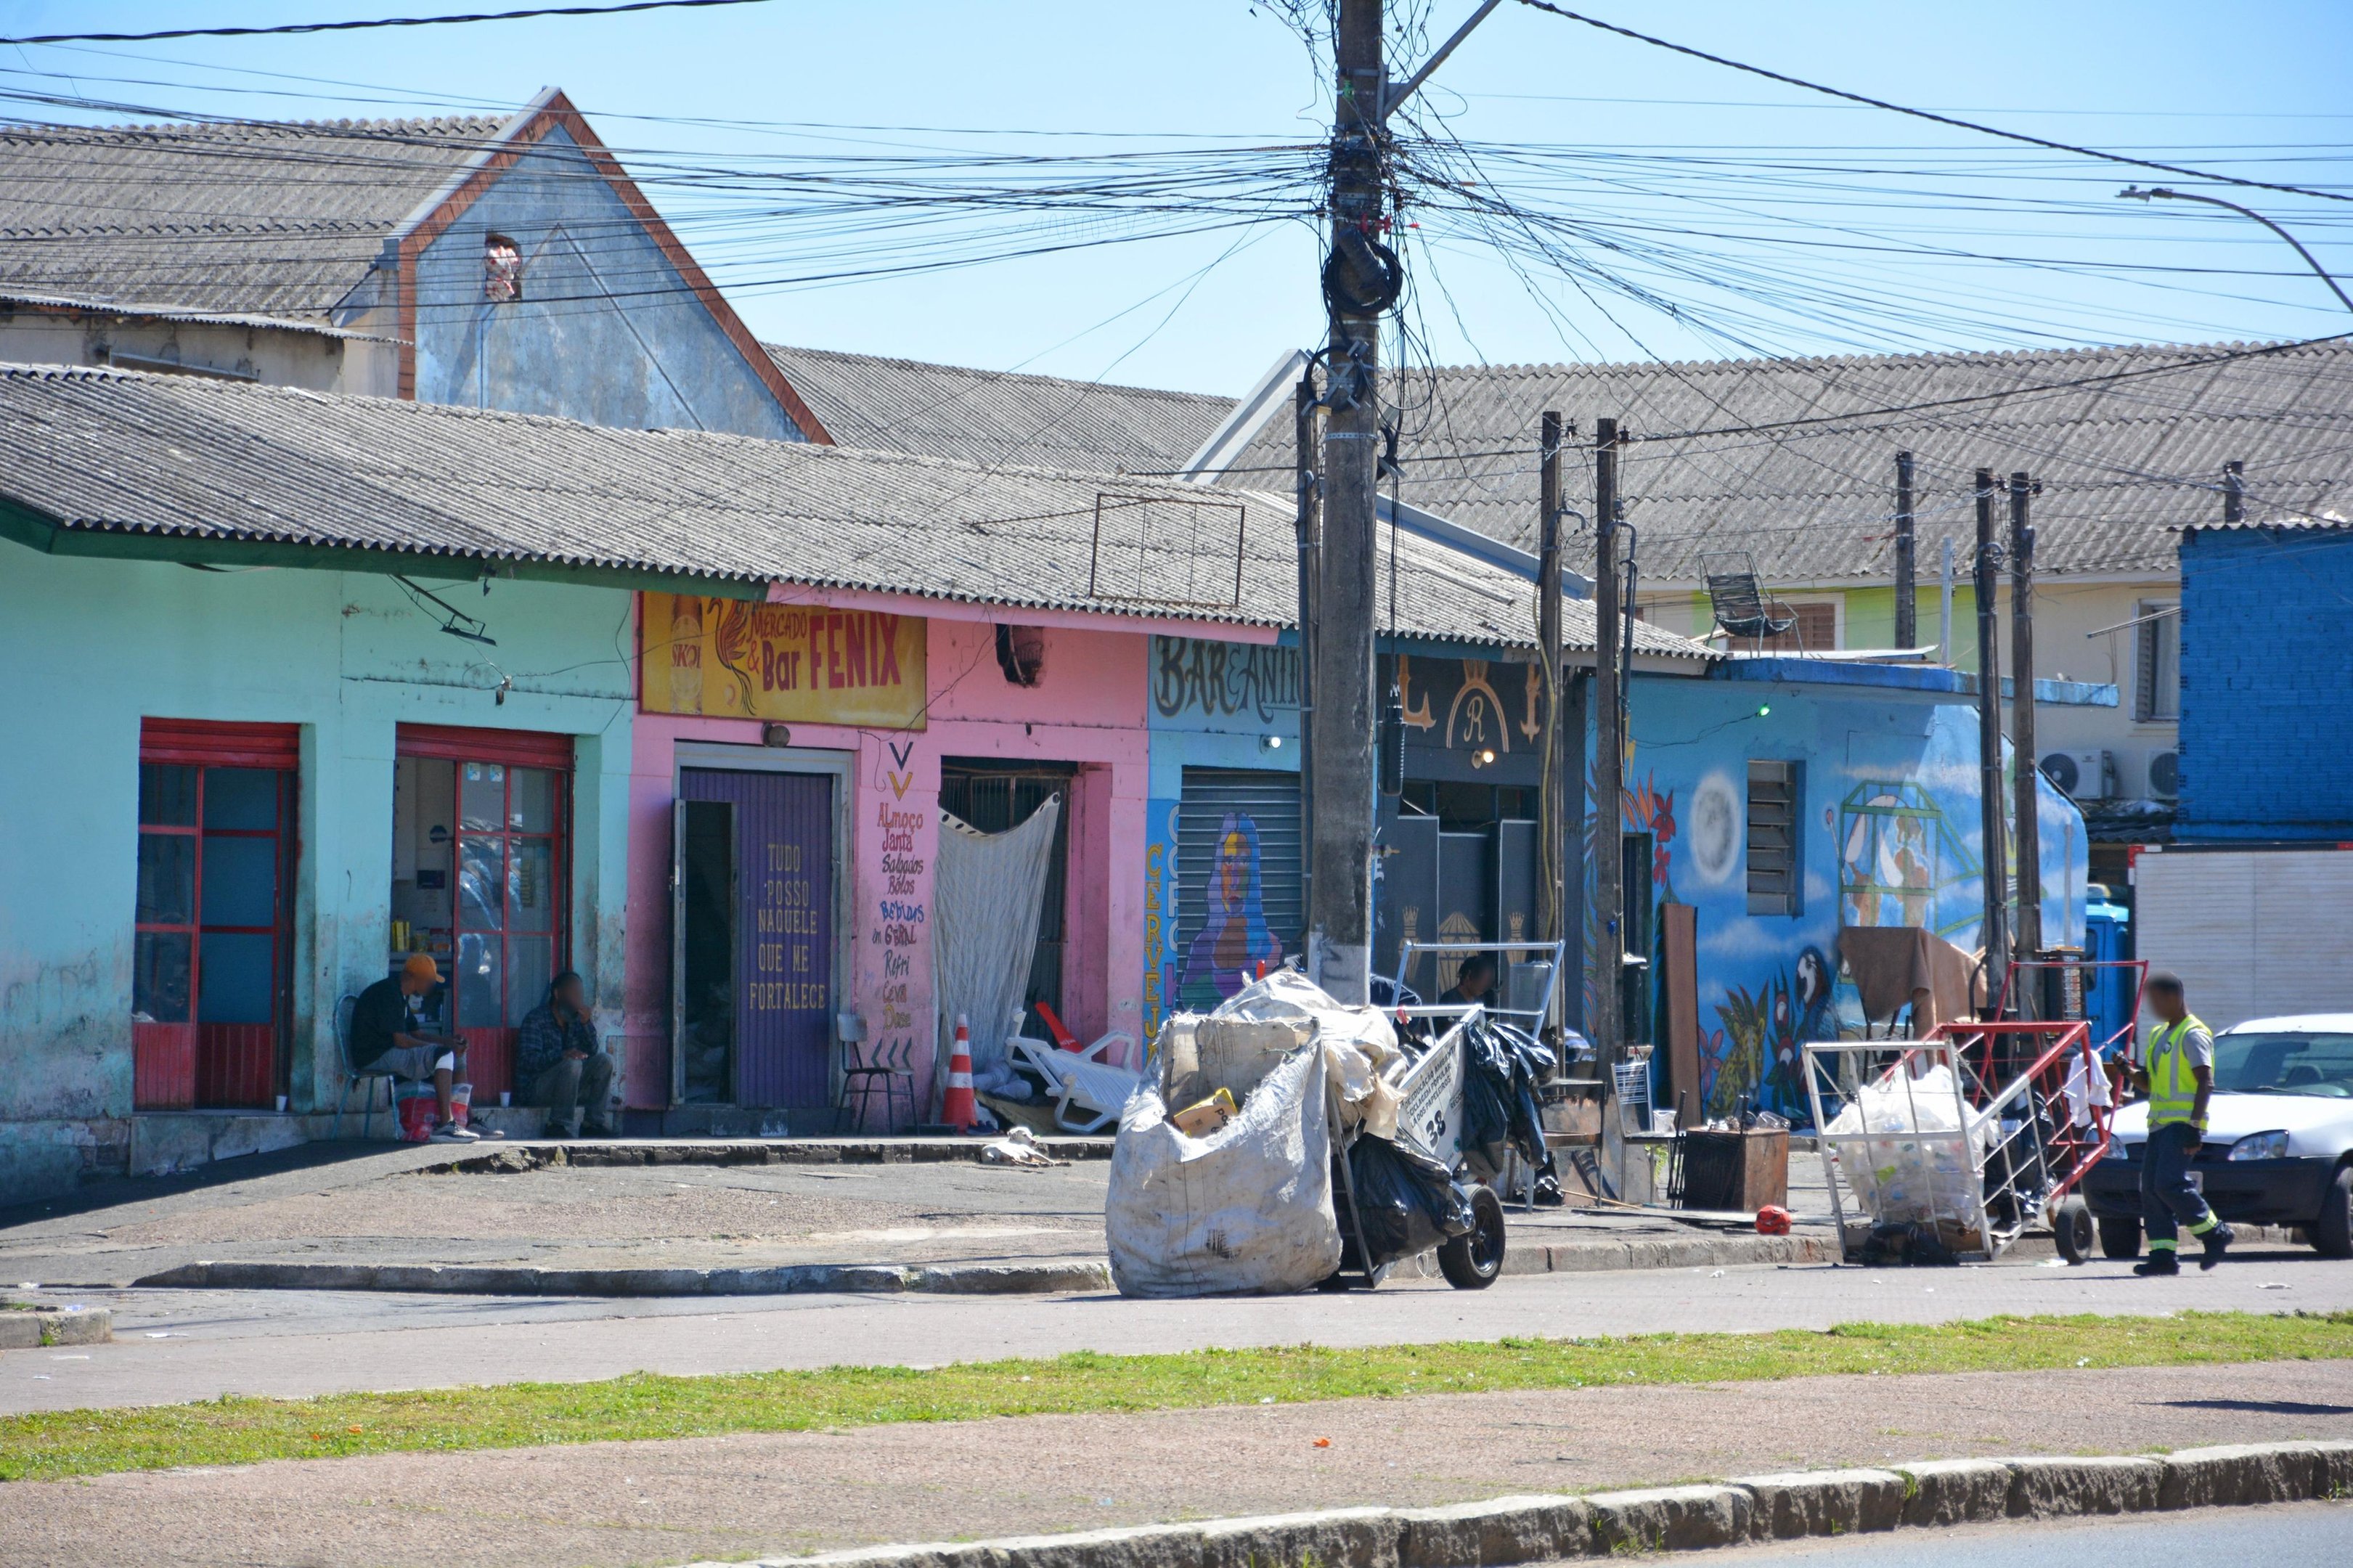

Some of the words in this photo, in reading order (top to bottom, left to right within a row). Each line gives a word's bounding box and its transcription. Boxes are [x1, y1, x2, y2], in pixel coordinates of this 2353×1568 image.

[746, 611, 807, 643] MERCADO
[746, 640, 760, 675] &
[762, 640, 801, 691] Bar
[1154, 634, 1236, 718] BAR
[882, 828, 913, 852] Janta
[767, 844, 801, 872] TUDO
[882, 852, 923, 879] Salgados
[767, 879, 809, 907] POSSO
[887, 874, 915, 896] Bolos
[758, 909, 818, 934] NAQUELE
[758, 943, 783, 972] QUE
[793, 944, 809, 972] ME
[884, 949, 910, 980] Refri
[749, 982, 825, 1010] FORTALECE
[1425, 1110, 1446, 1148] 38
